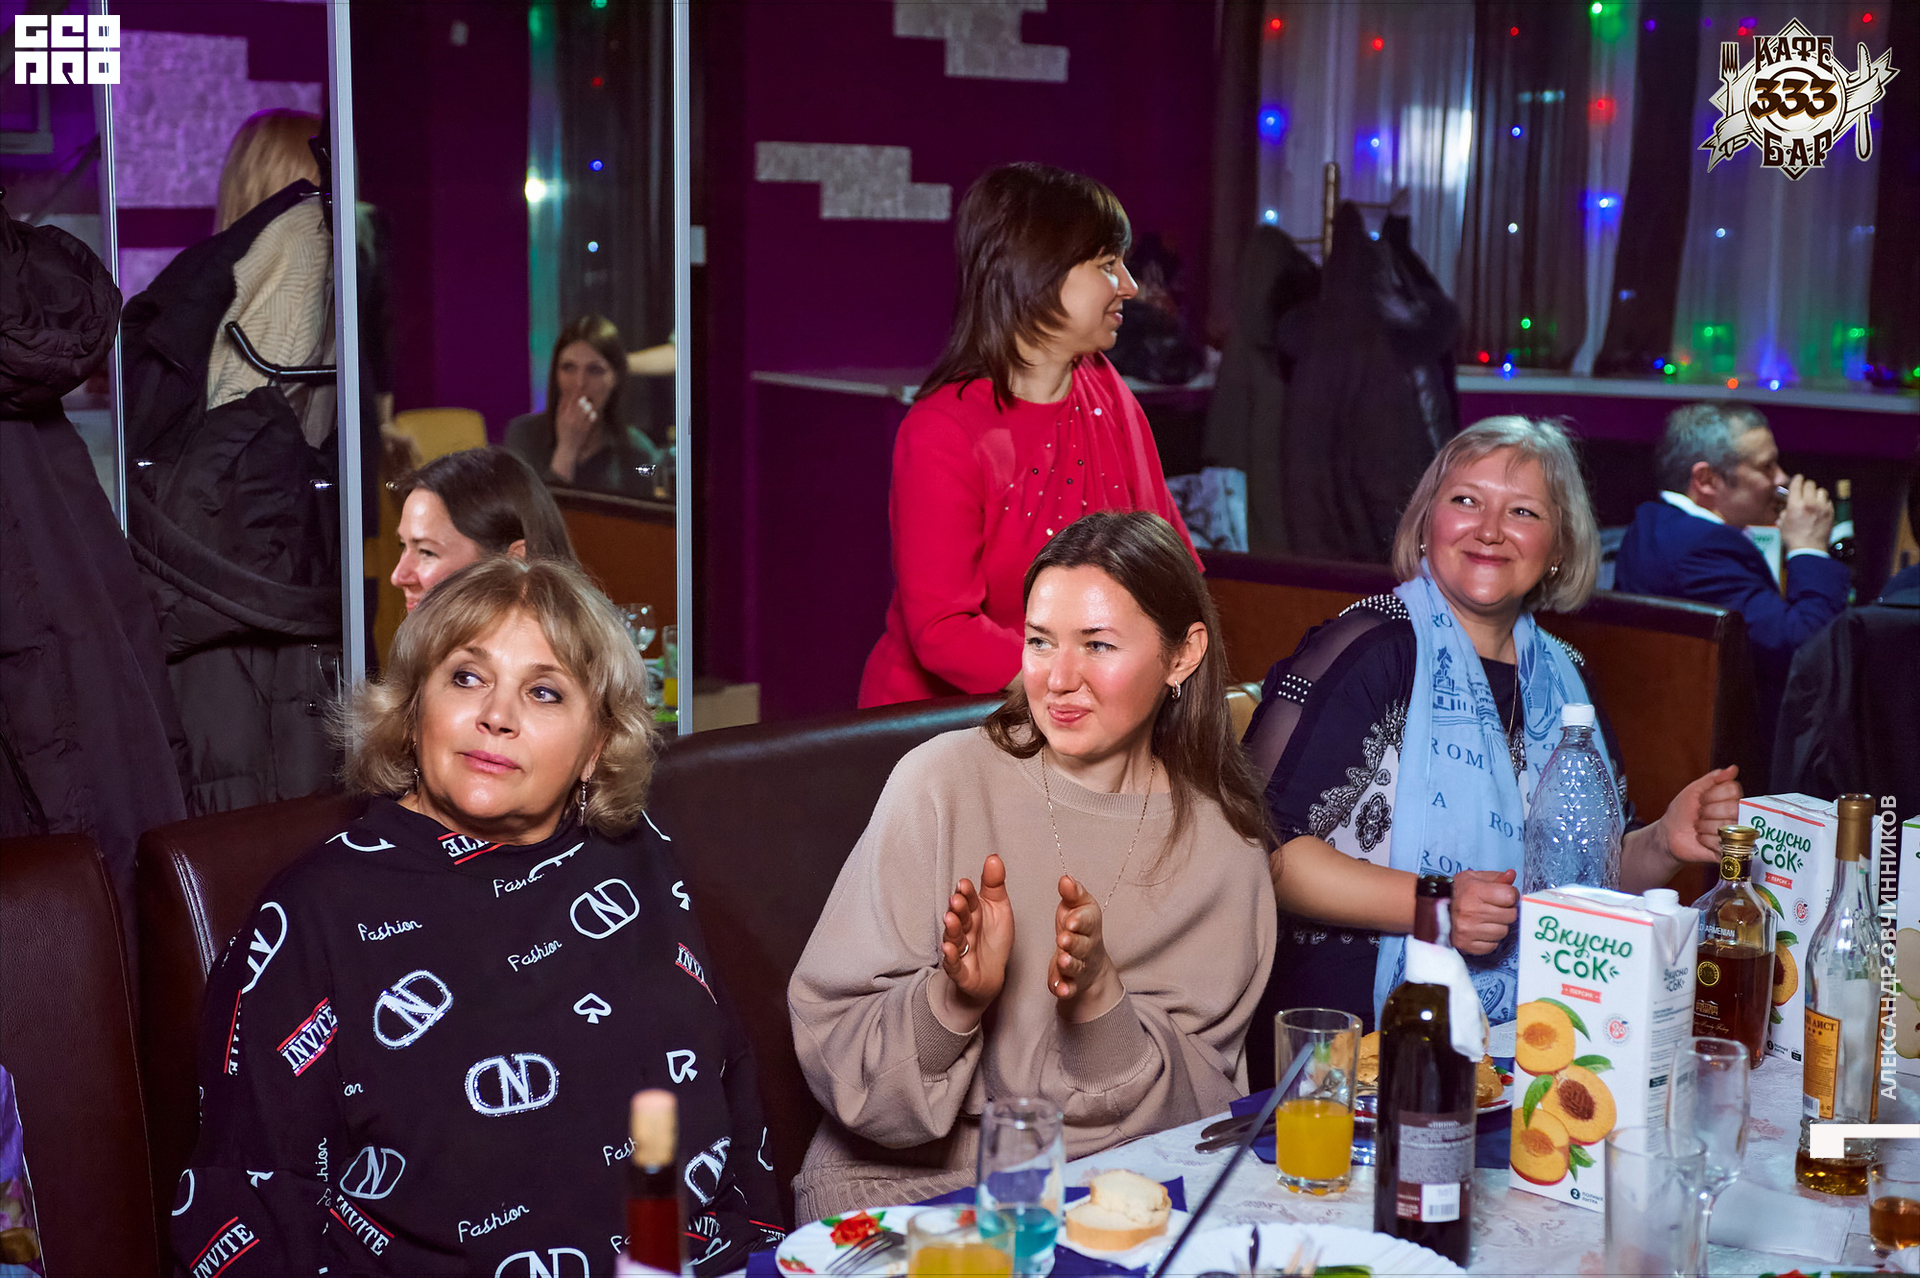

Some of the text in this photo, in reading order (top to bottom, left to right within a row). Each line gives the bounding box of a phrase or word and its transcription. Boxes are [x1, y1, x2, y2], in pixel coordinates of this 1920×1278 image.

[1751, 815, 1811, 853] Вкусно
[357, 918, 423, 941] Fashion
[1534, 915, 1633, 959] Вкусно
[507, 939, 563, 972] Fashion
[282, 1005, 338, 1070] INVITE
[603, 1137, 638, 1166] Fash
[458, 1204, 530, 1243] Fashion
